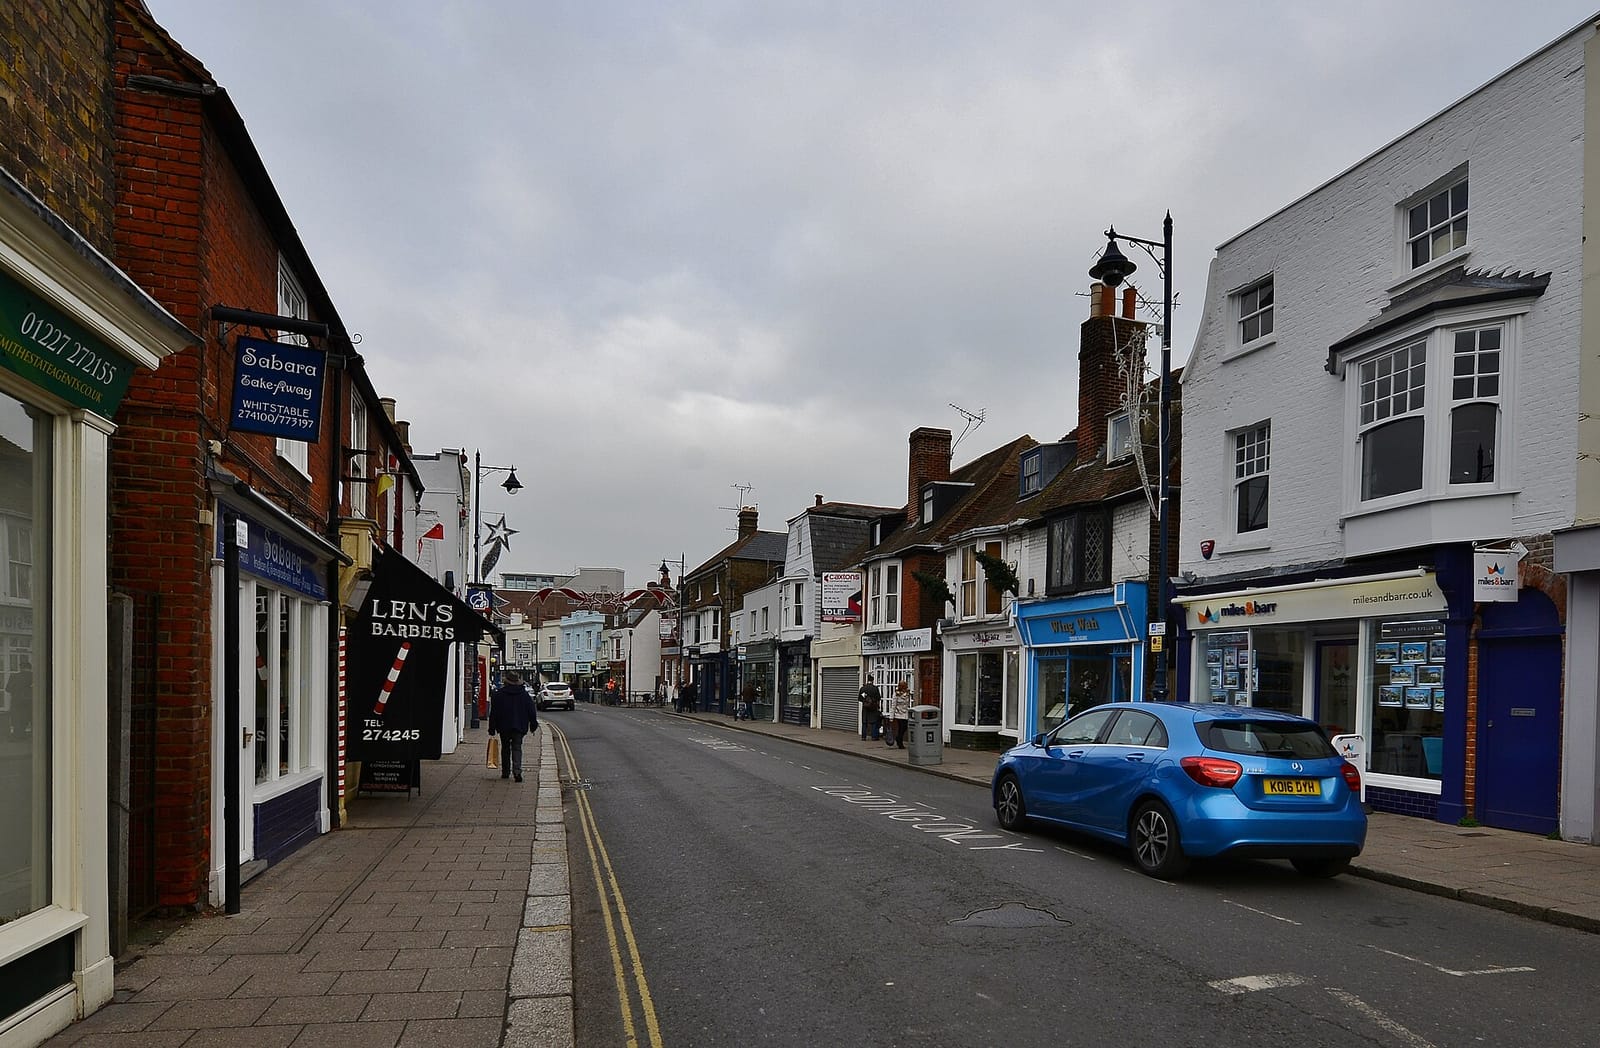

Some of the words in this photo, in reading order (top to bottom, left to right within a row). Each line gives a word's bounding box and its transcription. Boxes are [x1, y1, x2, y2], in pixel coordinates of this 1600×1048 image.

[21, 312, 71, 355] 01227
[66, 342, 117, 385] 272155
[242, 347, 316, 377] Sabara
[240, 374, 312, 401] Take-Away
[242, 399, 310, 418] WHITSTABLE
[238, 409, 314, 429] 274100/773197
[263, 528, 303, 574] Sabara
[1352, 588, 1433, 605] milesandbarr.co.uk
[371, 599, 453, 622] LEN'S
[371, 622, 455, 641] BARBERS
[1051, 620, 1075, 635] Wing
[1077, 617, 1099, 632] Wah
[364, 719, 384, 727] TEL:
[362, 729, 420, 741] 274245
[1270, 781, 1293, 793] KO16
[1296, 781, 1315, 793] DYH
[911, 823, 1044, 852] ONLY
